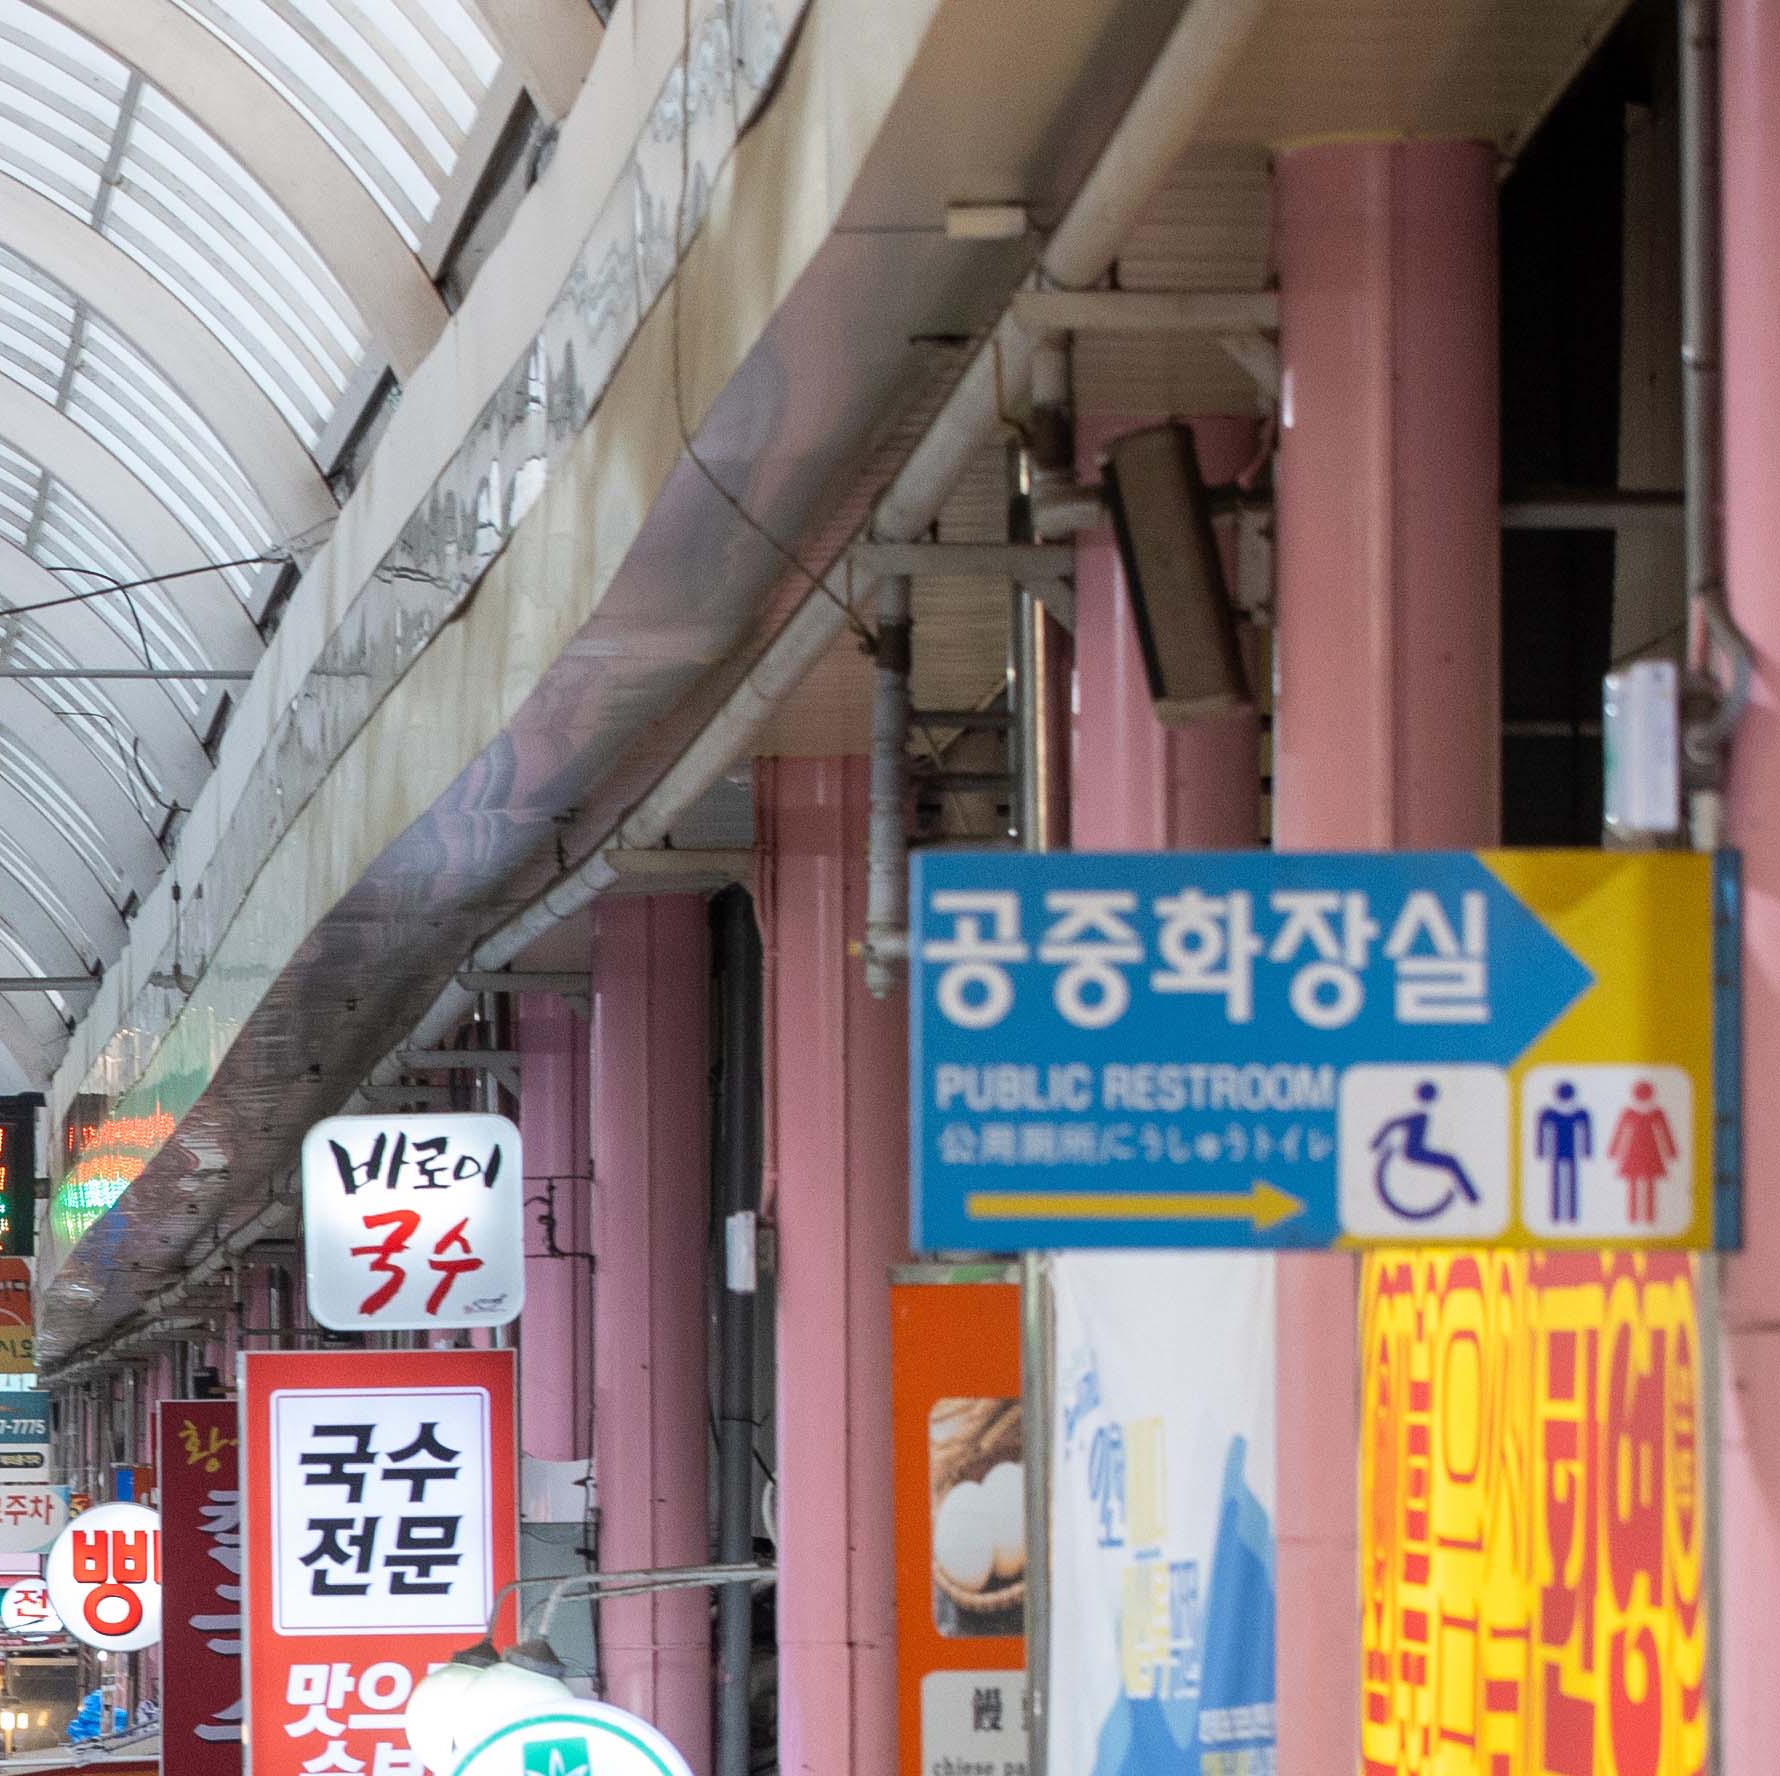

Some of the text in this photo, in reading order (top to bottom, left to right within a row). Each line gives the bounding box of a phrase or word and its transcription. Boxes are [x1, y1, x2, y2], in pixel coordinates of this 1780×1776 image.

[922, 888, 1494, 1030] 공중화장실
[935, 1062, 1336, 1112] PUBLIC RESTROOM
[351, 1208, 487, 1318] 국수
[298, 1421, 462, 1504] 국수
[298, 1514, 464, 1596] 전문
[283, 1661, 446, 1738] 맛으
